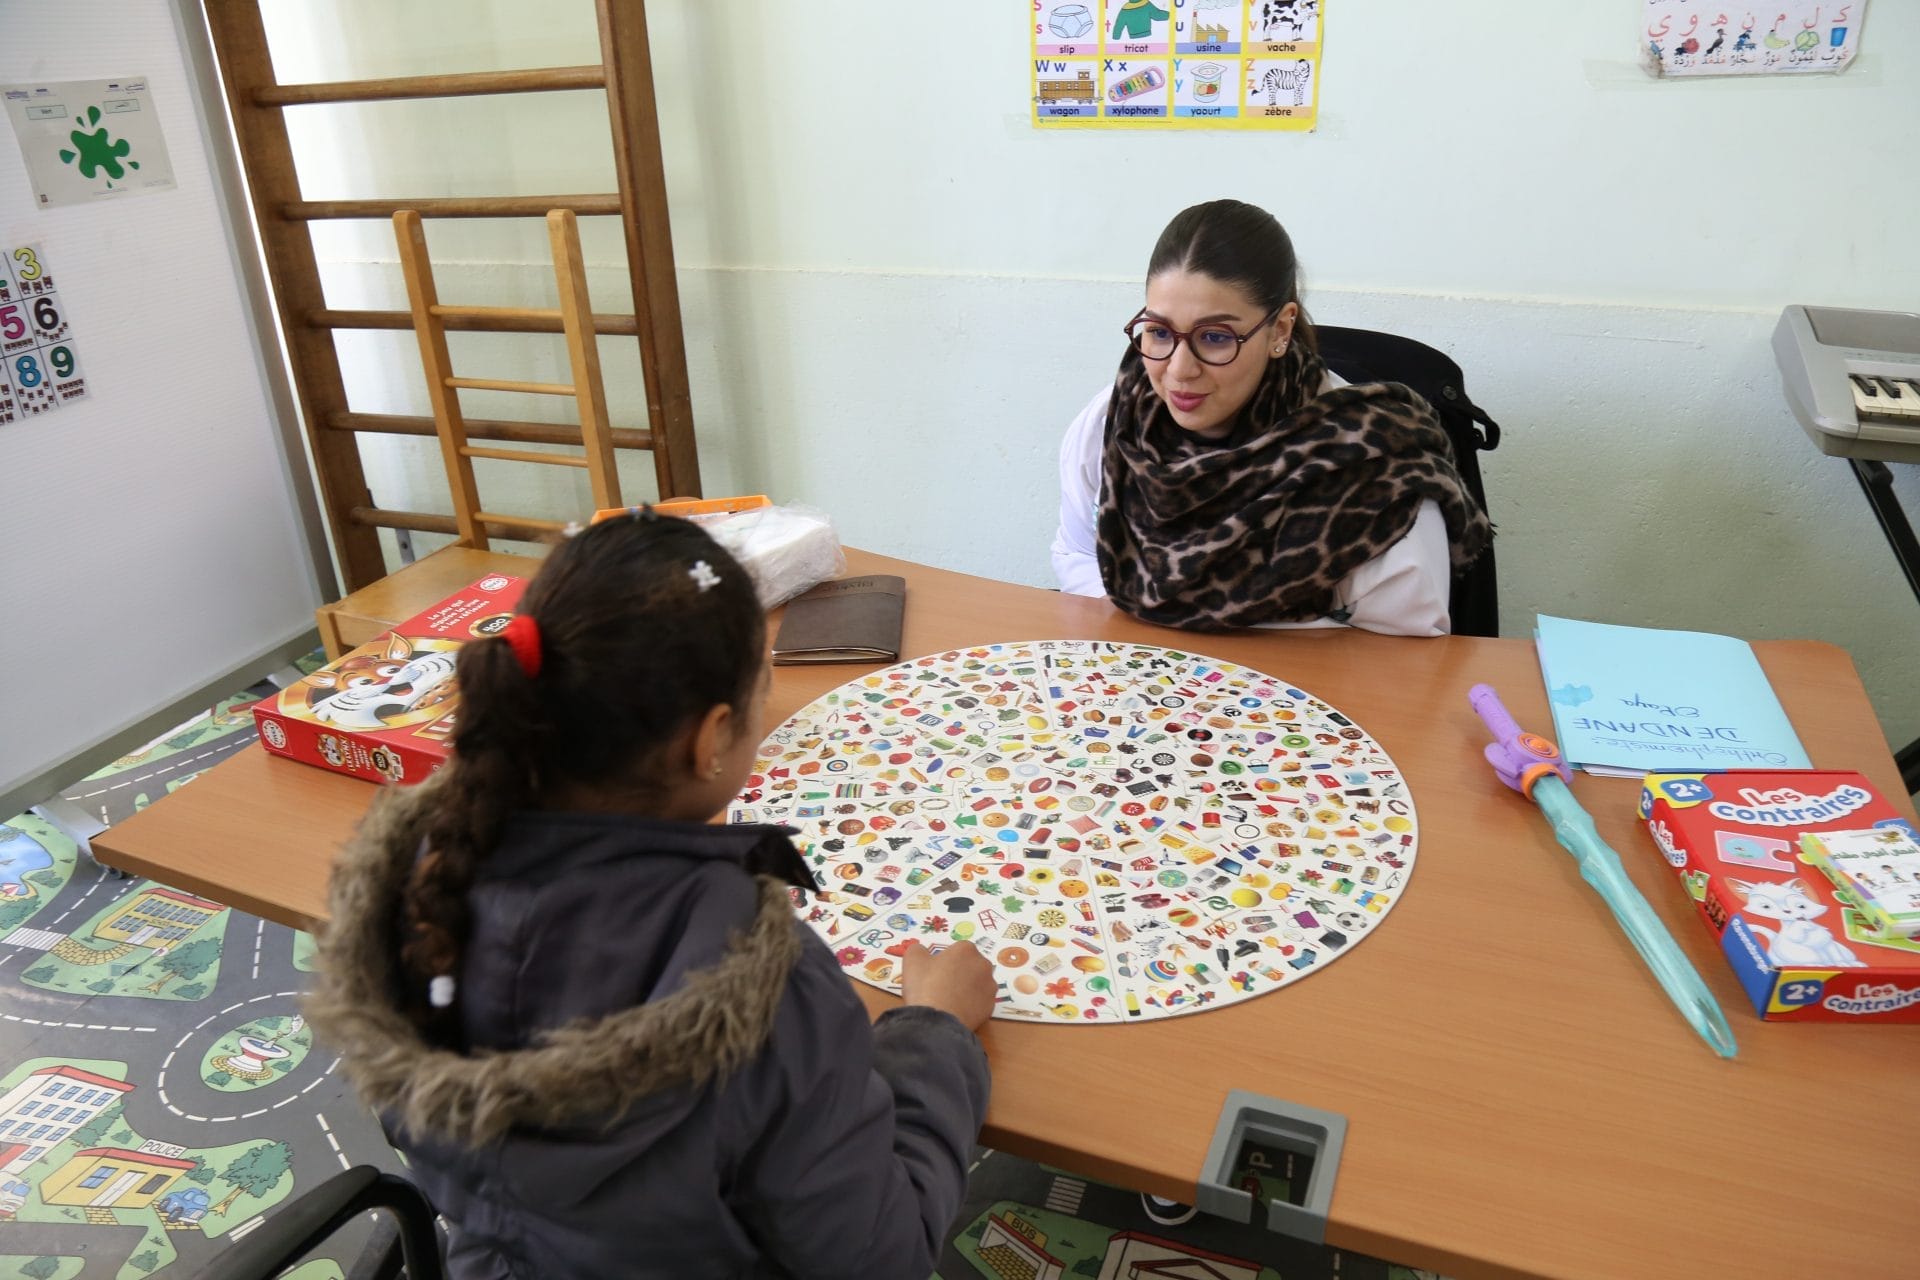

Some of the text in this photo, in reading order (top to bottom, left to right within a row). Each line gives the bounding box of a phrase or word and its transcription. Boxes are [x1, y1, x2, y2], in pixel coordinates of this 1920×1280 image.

[1059, 44, 1075, 55] slip
[1124, 44, 1149, 53] tricot
[1196, 43, 1222, 52] usine
[1267, 43, 1296, 52] vache
[1035, 60, 1067, 72] W w
[1103, 59, 1127, 72] X x
[1173, 58, 1183, 71] Y
[1245, 58, 1255, 71] Z
[1175, 79, 1183, 92] y
[1247, 79, 1255, 89] z
[1049, 108, 1079, 117] wagon
[1112, 106, 1159, 117] xylophone
[1190, 107, 1221, 116] yaourt
[1265, 107, 1292, 116] zèbre
[14, 247, 42, 281] 3
[0, 297, 59, 340] 5 6
[16, 346, 75, 388] 8 9
[1572, 717, 1748, 743] DENDANE
[1669, 783, 1703, 798] 2+
[1745, 790, 1802, 806] Les
[1716, 788, 1865, 823] contraires
[1786, 984, 1819, 1000] 2+
[1859, 985, 1895, 998] Les
[1826, 990, 1920, 1012] contraire
[143, 1140, 183, 1157] POLICE
[1011, 1217, 1037, 1240] BUS
